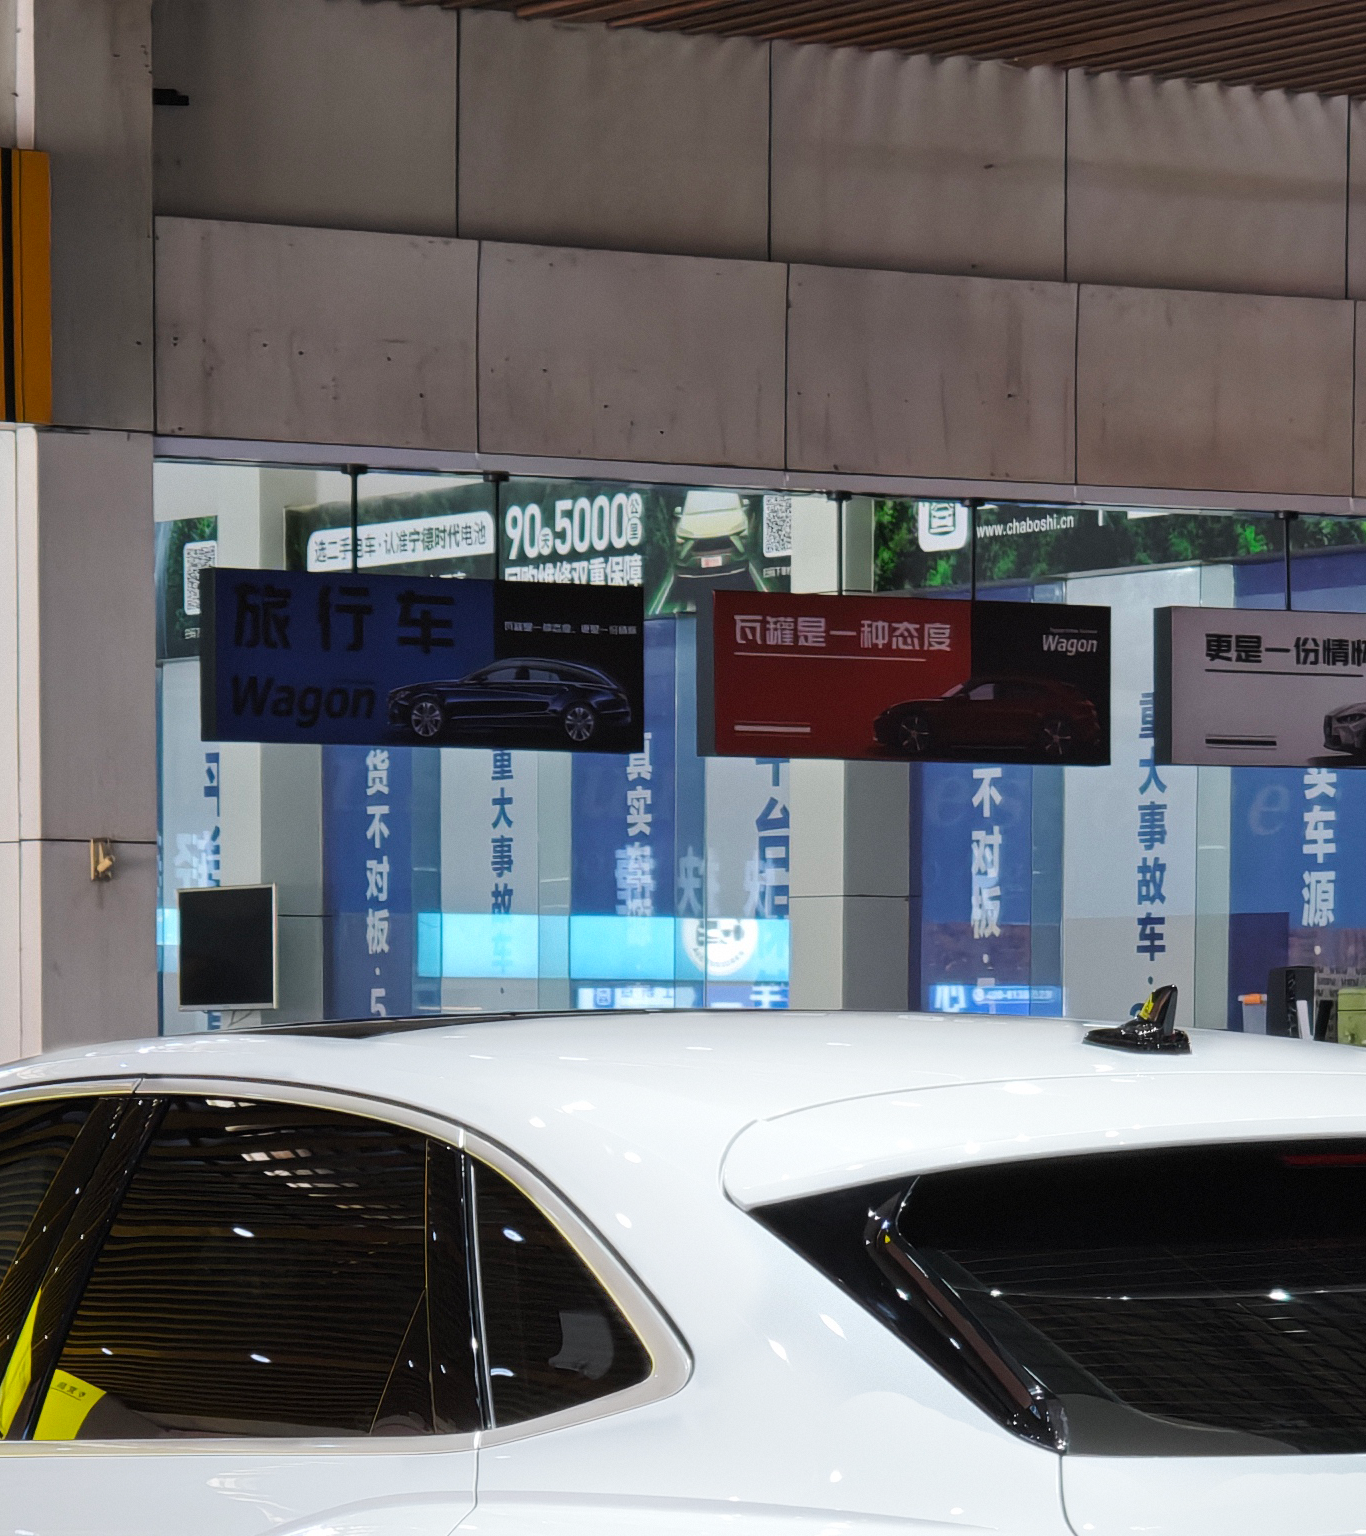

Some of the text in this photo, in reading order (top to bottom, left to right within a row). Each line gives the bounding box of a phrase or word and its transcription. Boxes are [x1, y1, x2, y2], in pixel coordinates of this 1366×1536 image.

[976, 514, 1075, 538] www.chaboshi.cn
[233, 582, 456, 655] 旅行车
[733, 615, 952, 652] 瓦罐是一种态度
[1041, 633, 1098, 656] Wagon
[231, 675, 377, 729] Wagon
